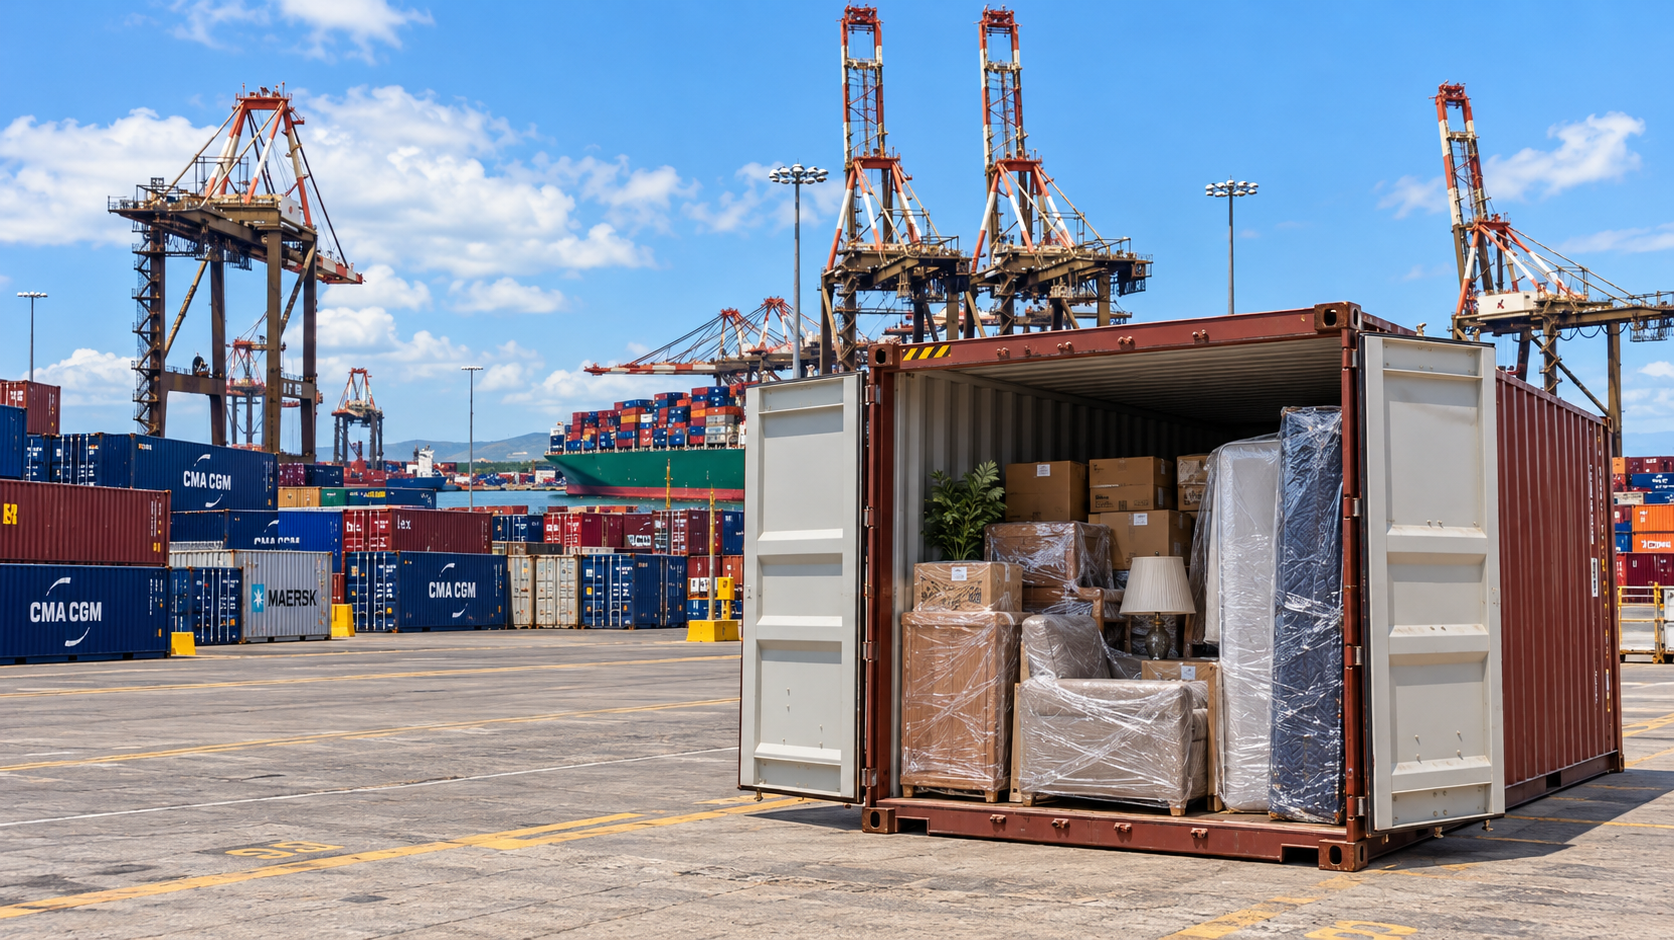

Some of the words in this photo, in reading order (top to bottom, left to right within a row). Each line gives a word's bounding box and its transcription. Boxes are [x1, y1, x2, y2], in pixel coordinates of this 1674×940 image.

[183, 470, 206, 489] CMA
[208, 473, 232, 491] CGM
[267, 589, 317, 607] MAERSK
[428, 581, 452, 598] CMA
[454, 581, 476, 599] CGM
[29, 601, 67, 623] CMA
[69, 601, 102, 622] CGM
